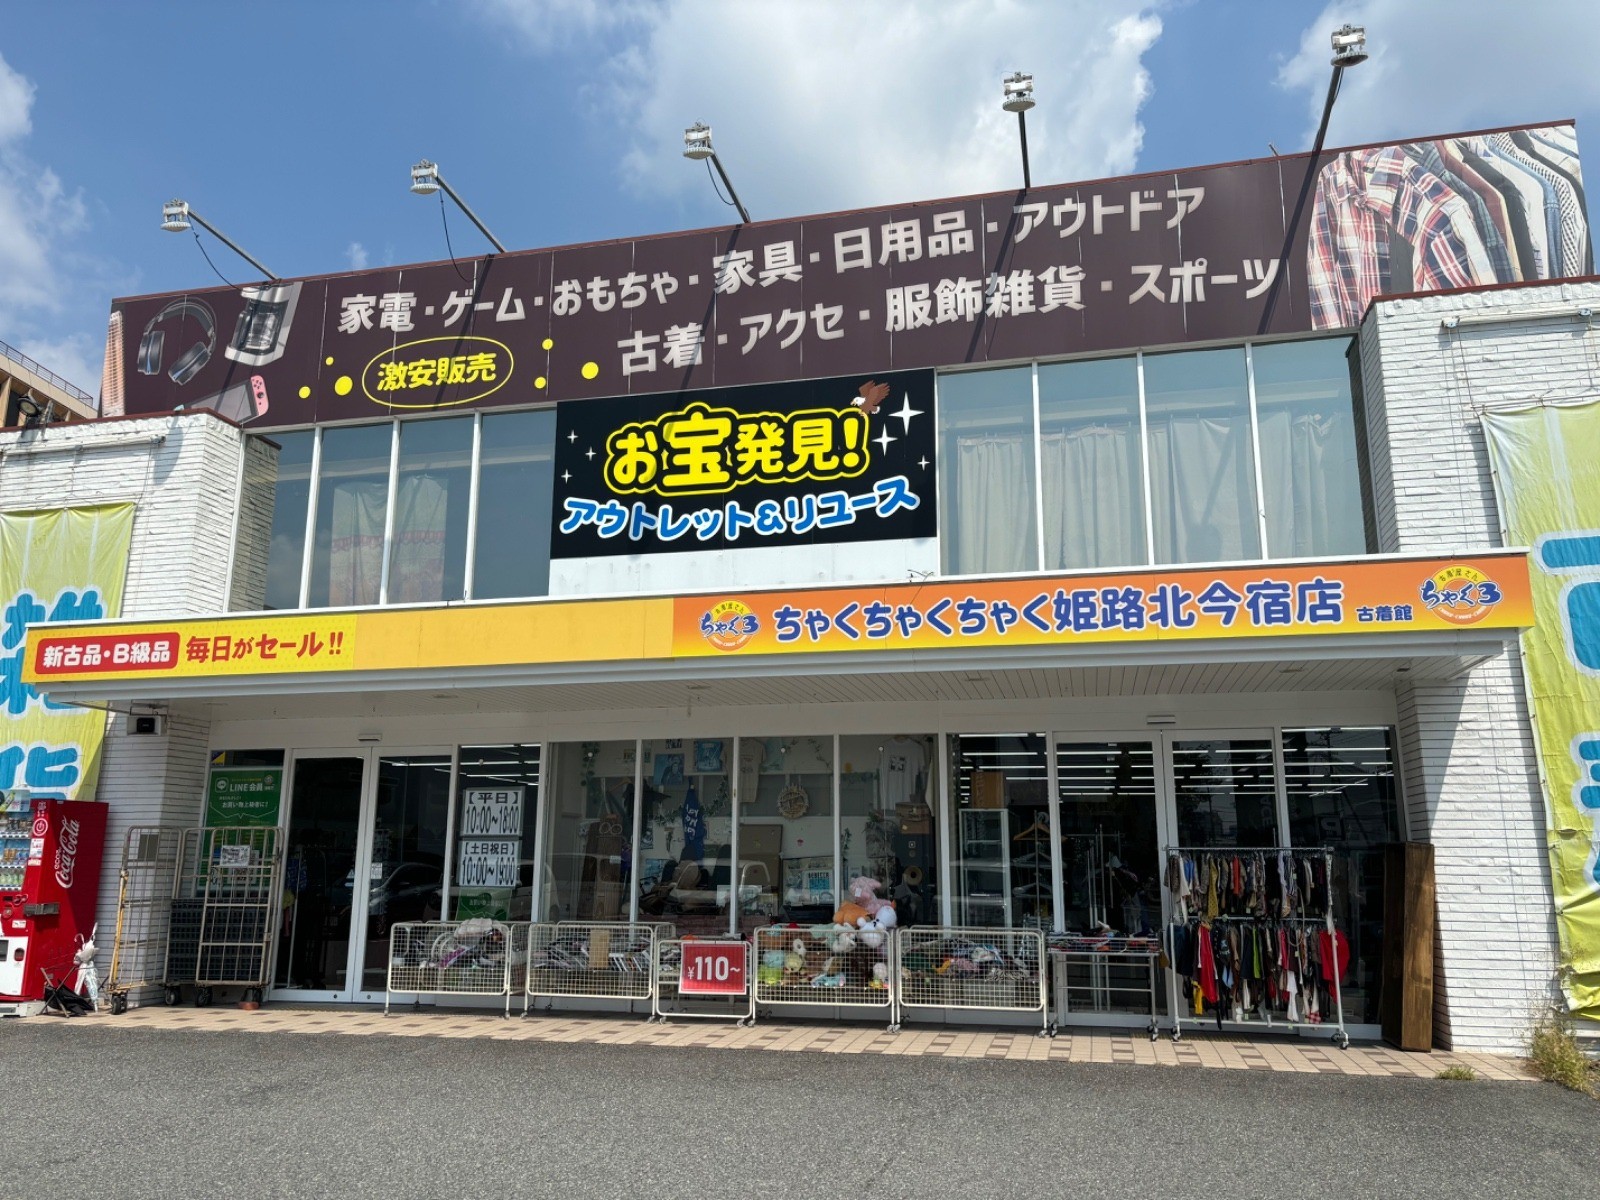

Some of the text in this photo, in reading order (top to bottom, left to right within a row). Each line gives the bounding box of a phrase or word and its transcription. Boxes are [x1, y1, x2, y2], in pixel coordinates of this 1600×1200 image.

[376, 352, 498, 392] 激安販売
[610, 410, 862, 488] お宝発見!
[559, 475, 921, 542] アウトレット&リユース
[772, 577, 1344, 642] ちゃくちゃくちゃく姫路北今宿店
[1356, 604, 1414, 623] 古着館
[43, 640, 171, 669] 新古品・B級品
[186, 630, 345, 664] 毎日がセール!!
[55, 815, 80, 888] Coca-Cola
